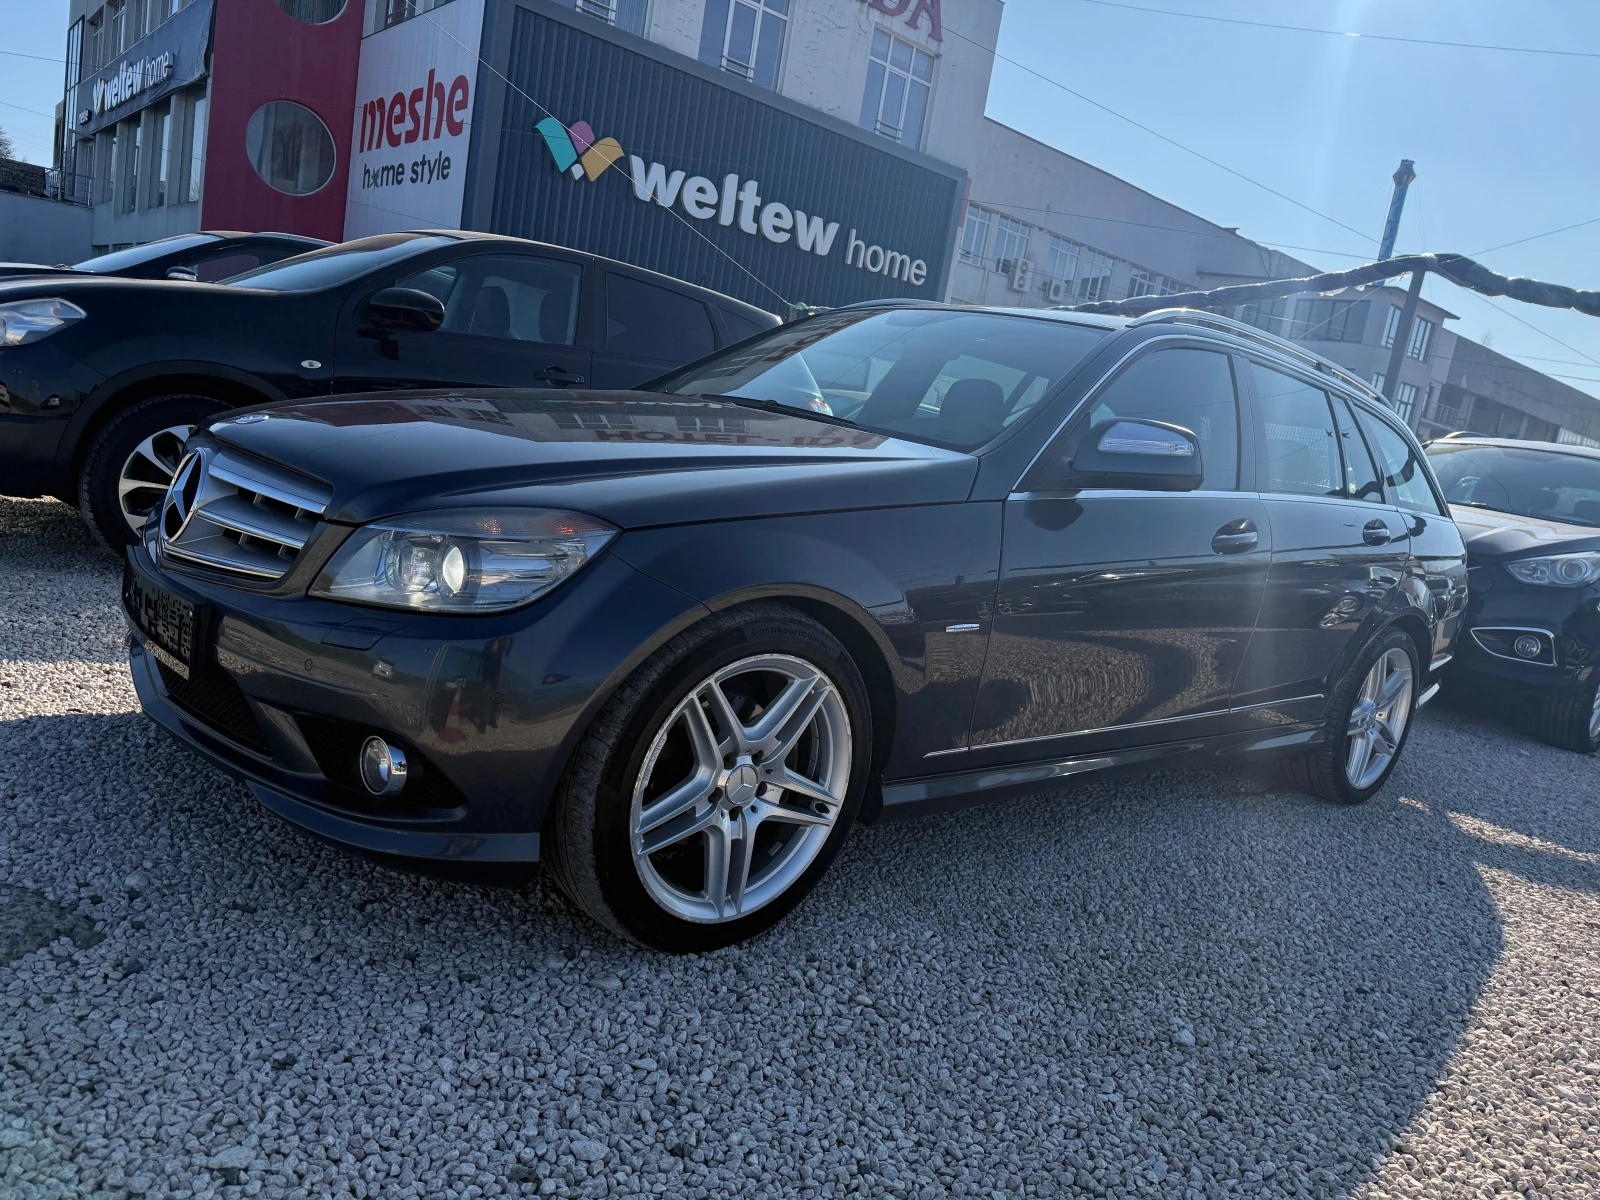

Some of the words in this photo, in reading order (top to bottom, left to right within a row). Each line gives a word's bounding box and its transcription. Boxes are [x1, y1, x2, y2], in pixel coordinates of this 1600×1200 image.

[104, 59, 144, 111] weltew
[144, 51, 170, 88] home
[359, 68, 469, 153] meshe
[410, 151, 451, 184] style
[629, 155, 840, 256] weltew
[845, 229, 927, 286] home
